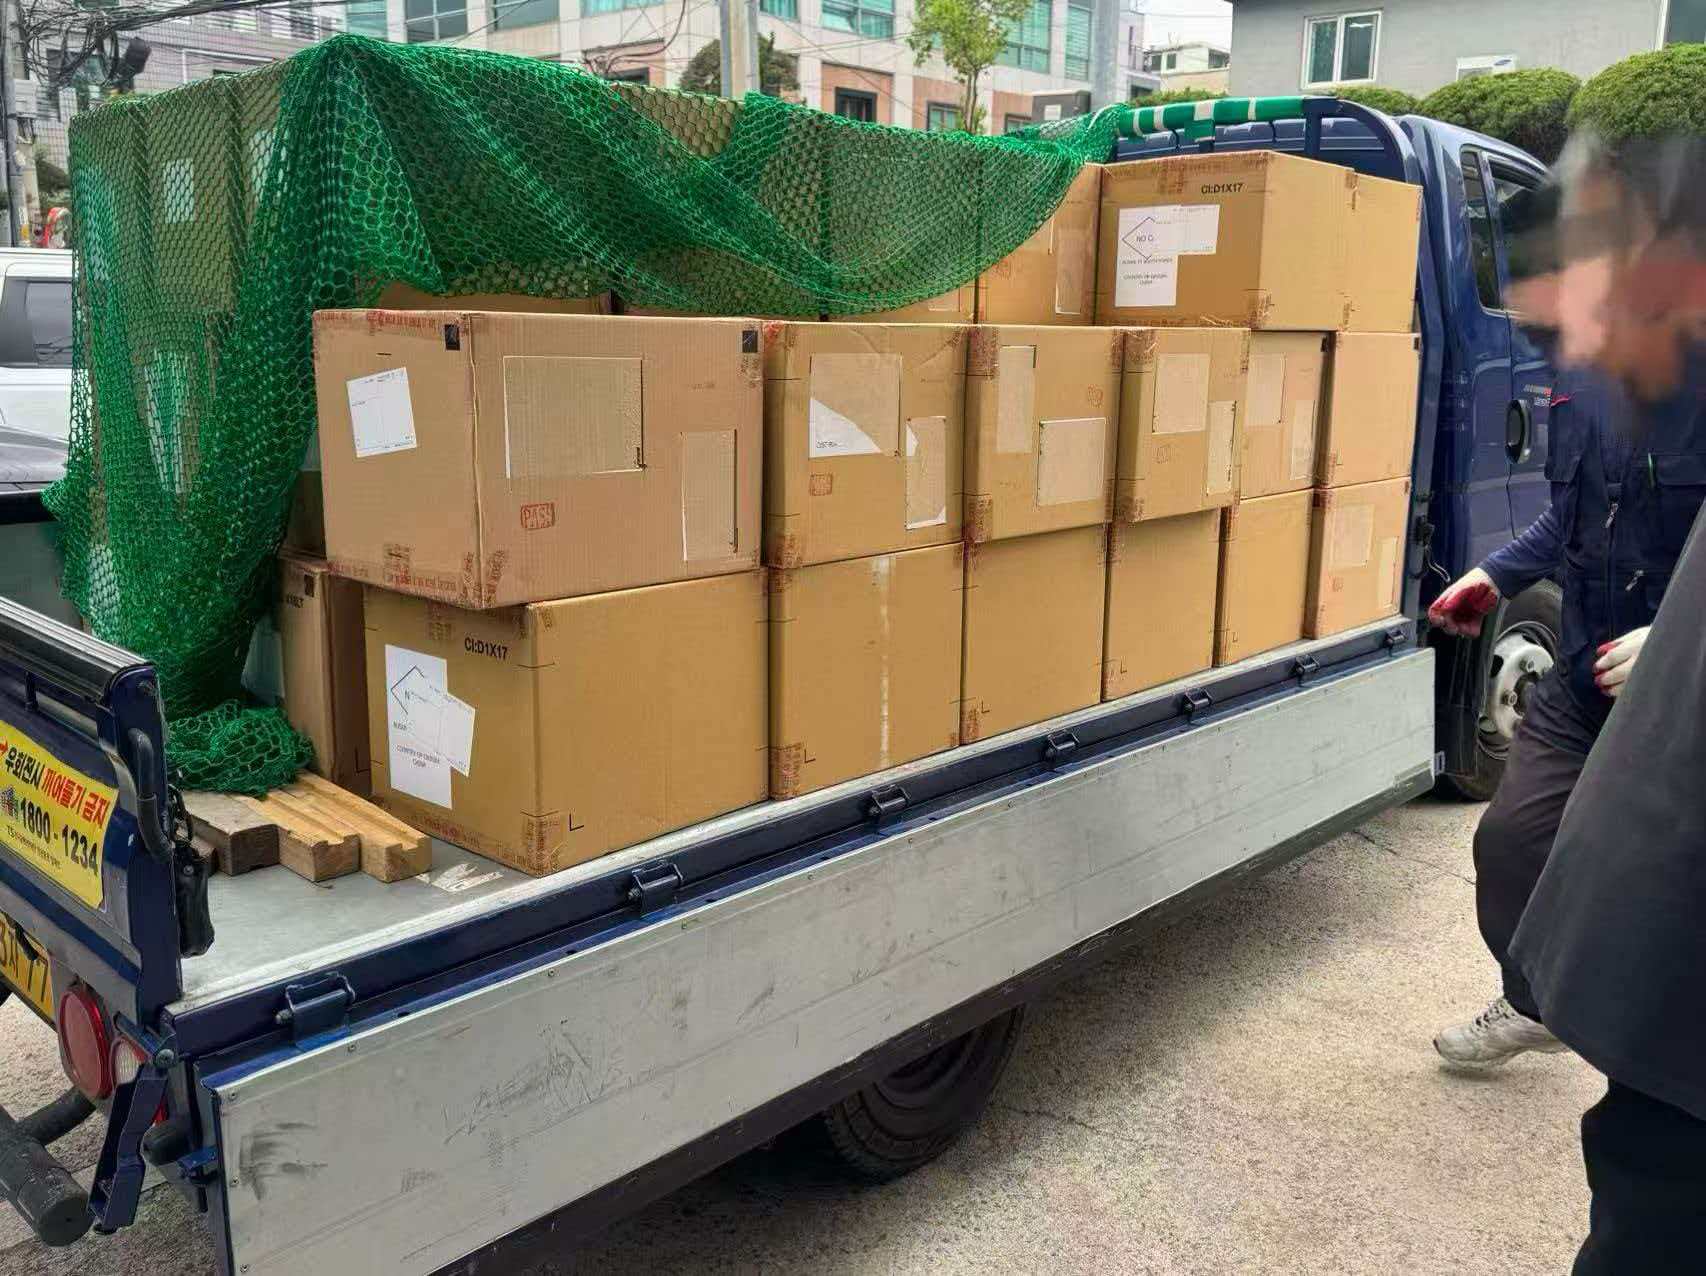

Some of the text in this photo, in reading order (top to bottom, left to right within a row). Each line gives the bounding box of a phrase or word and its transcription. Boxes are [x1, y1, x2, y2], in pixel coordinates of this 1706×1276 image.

[1201, 182, 1243, 194] CI:D1X17
[464, 637, 508, 662] CI:D1X17
[5, 746, 45, 790] 우회전시
[41, 768, 87, 815] 끼어들기
[81, 791, 110, 829] 금지
